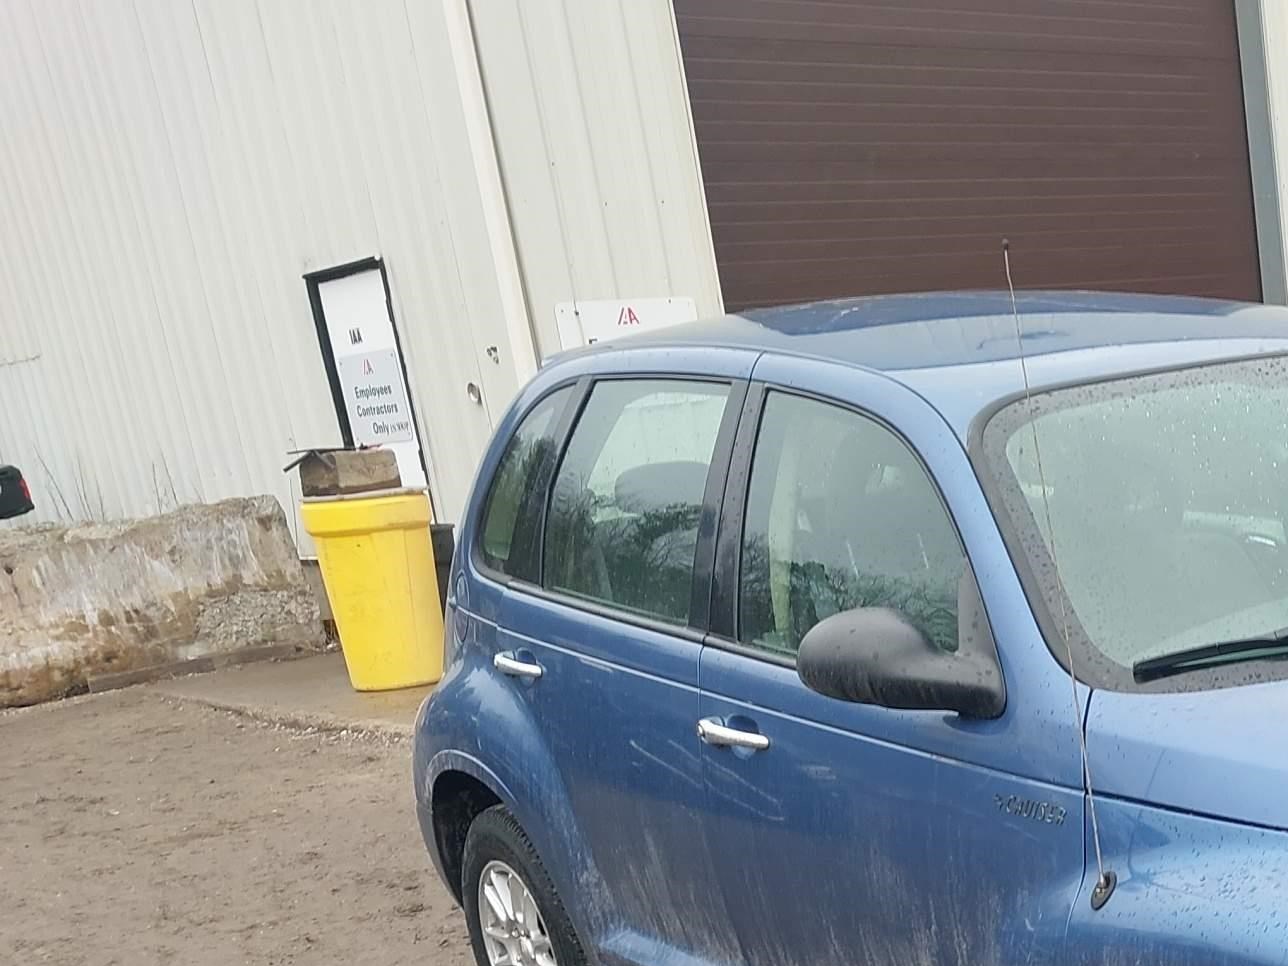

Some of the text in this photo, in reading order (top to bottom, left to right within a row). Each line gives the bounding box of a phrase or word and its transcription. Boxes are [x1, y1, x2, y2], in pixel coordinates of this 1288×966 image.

[349, 328, 363, 345] IAA
[354, 384, 392, 400] Employees
[356, 403, 399, 418] Contractors
[372, 421, 390, 436] Only
